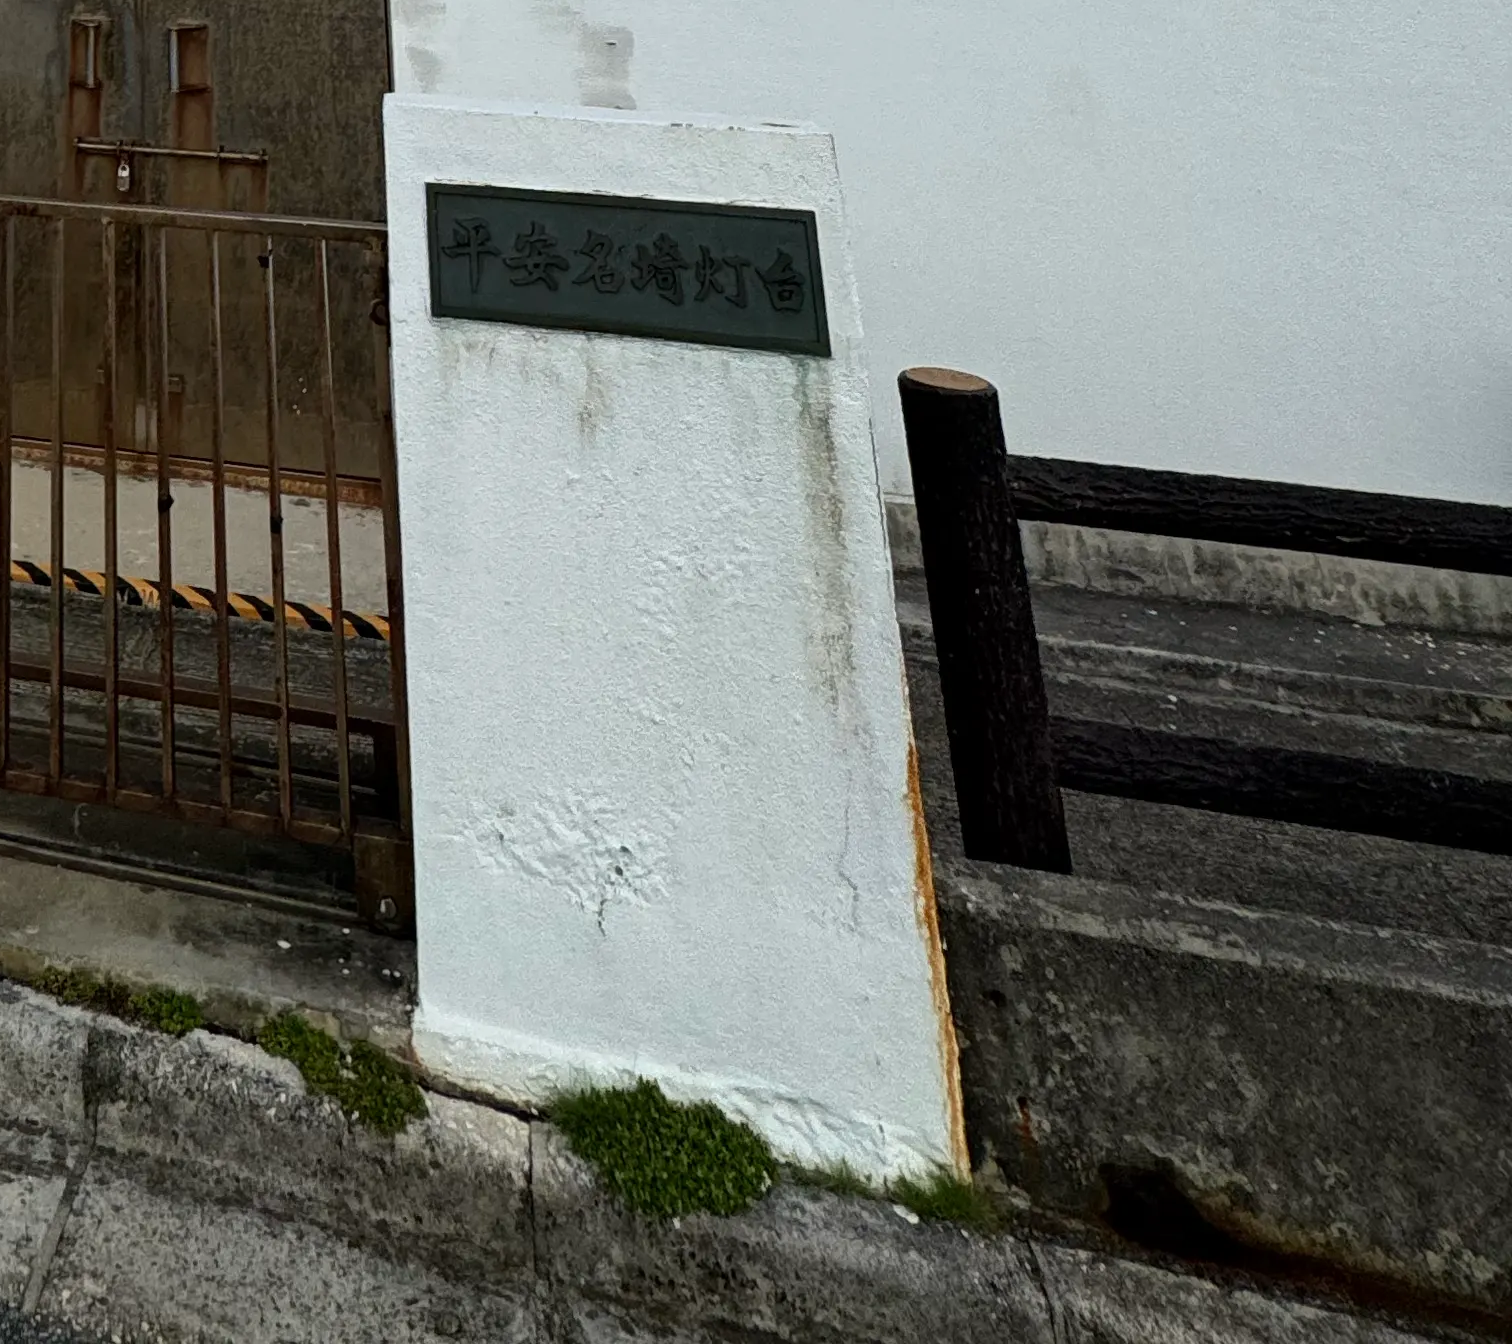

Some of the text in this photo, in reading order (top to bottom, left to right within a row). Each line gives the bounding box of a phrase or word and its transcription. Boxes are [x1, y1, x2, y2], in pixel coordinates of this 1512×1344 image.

[441, 217, 808, 313] 平安名埼灯台
